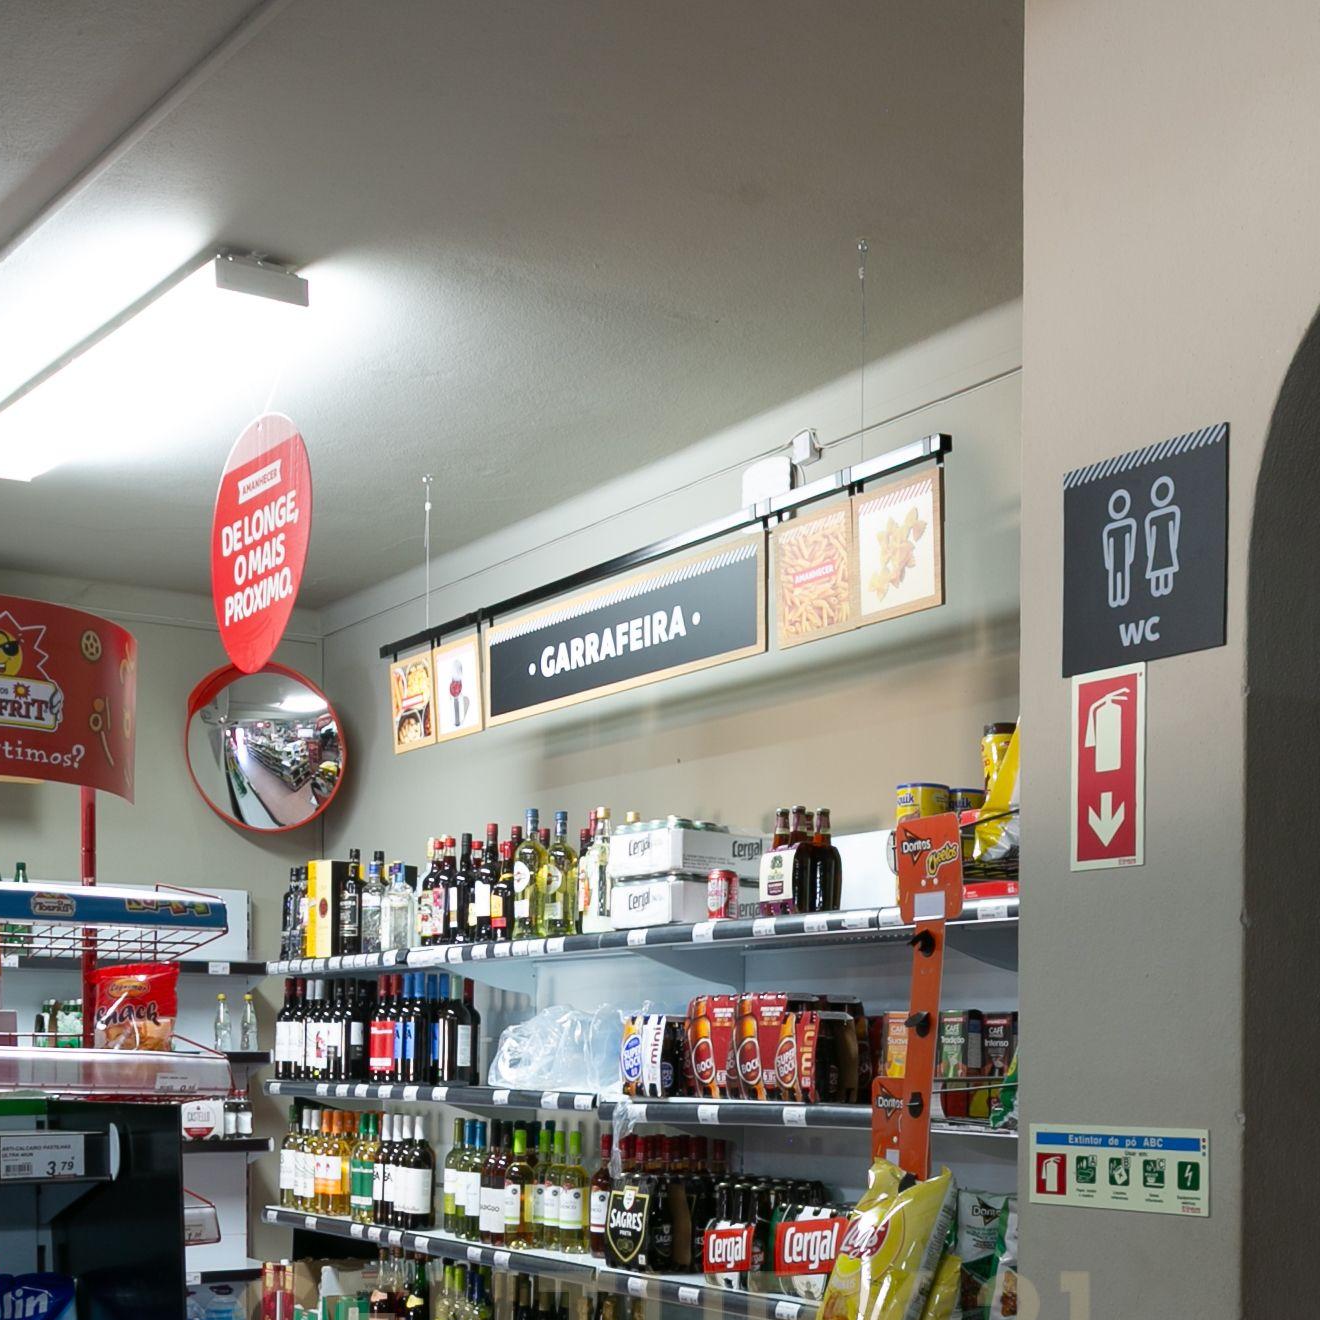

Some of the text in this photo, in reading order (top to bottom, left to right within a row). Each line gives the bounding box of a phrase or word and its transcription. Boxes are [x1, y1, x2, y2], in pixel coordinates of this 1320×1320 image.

[242, 468, 277, 494] AMANHECER
[222, 490, 299, 557] DE LONGE,
[234, 533, 285, 585] O MAIS
[540, 605, 686, 678] GARRAFEIRA
[1119, 616, 1160, 647] WC
[732, 838, 763, 861] Cergal
[901, 838, 931, 855] Doritos
[927, 843, 958, 875] Cheetos
[1068, 1135, 1163, 1148] Extintor de pó ABC
[610, 1208, 643, 1232] SAGRES
[708, 1231, 747, 1270] Cergal
[783, 1223, 840, 1272] Cergal
